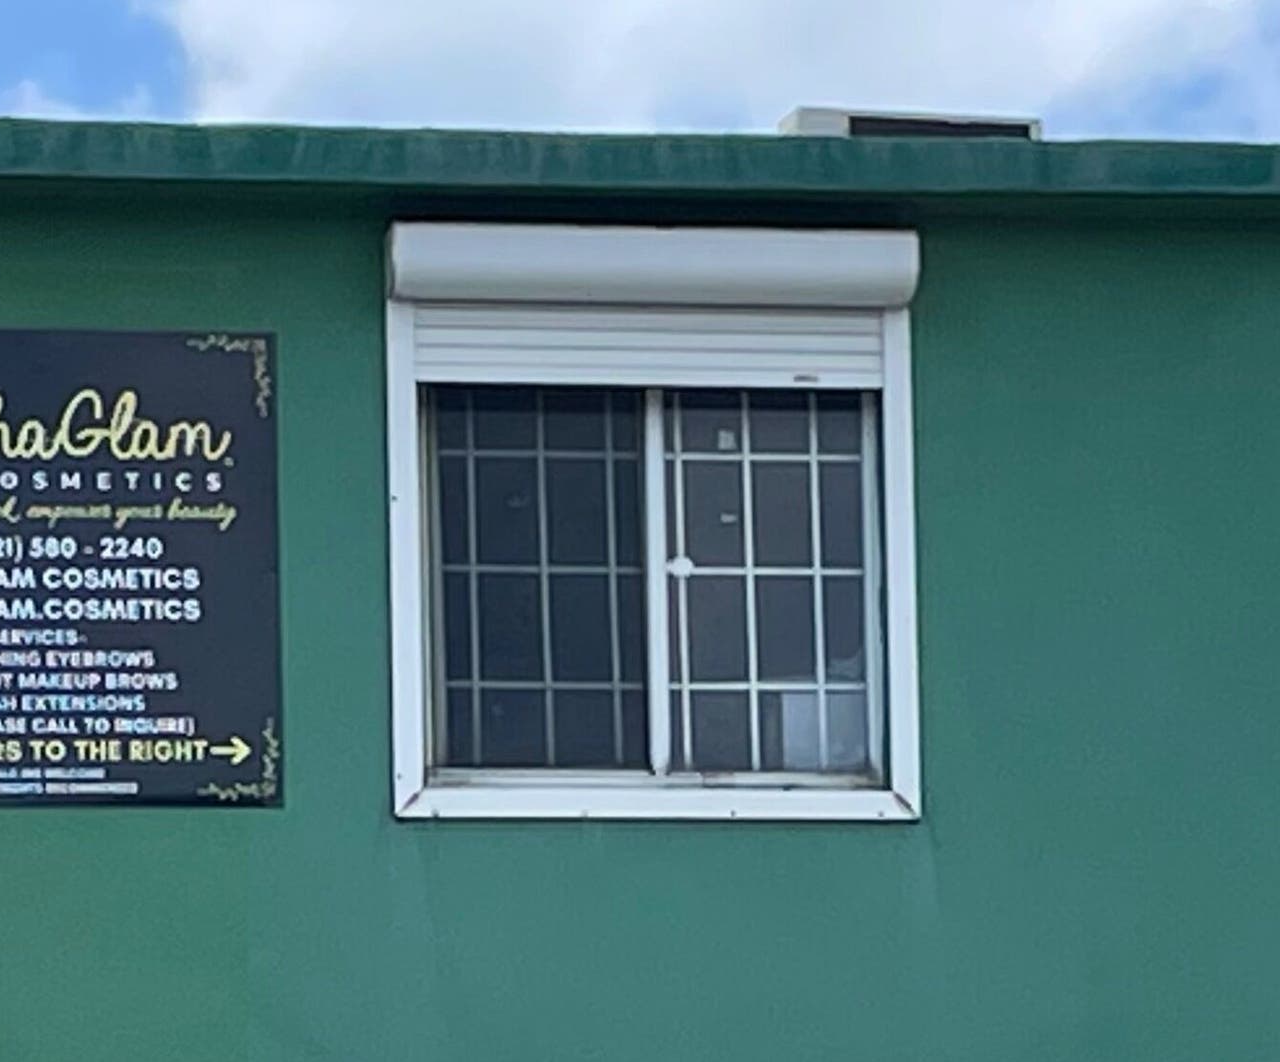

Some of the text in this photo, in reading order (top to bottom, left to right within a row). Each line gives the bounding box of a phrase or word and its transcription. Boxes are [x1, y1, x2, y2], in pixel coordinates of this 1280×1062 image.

[113, 504, 163, 529] your
[168, 497, 237, 531] beauty
[29, 536, 77, 558] 580
[99, 536, 164, 559] 2240
[43, 567, 200, 590] COSMETICS
[45, 651, 155, 668] EYEBROWS
[18, 673, 101, 690] MAKEUP
[105, 672, 178, 690] BROWS
[21, 694, 145, 711] EXTENSIONS
[32, 716, 79, 734] CALL
[84, 717, 110, 734] TO
[32, 740, 64, 761] TO
[73, 740, 121, 761] THE
[128, 740, 209, 761] RIGHT
